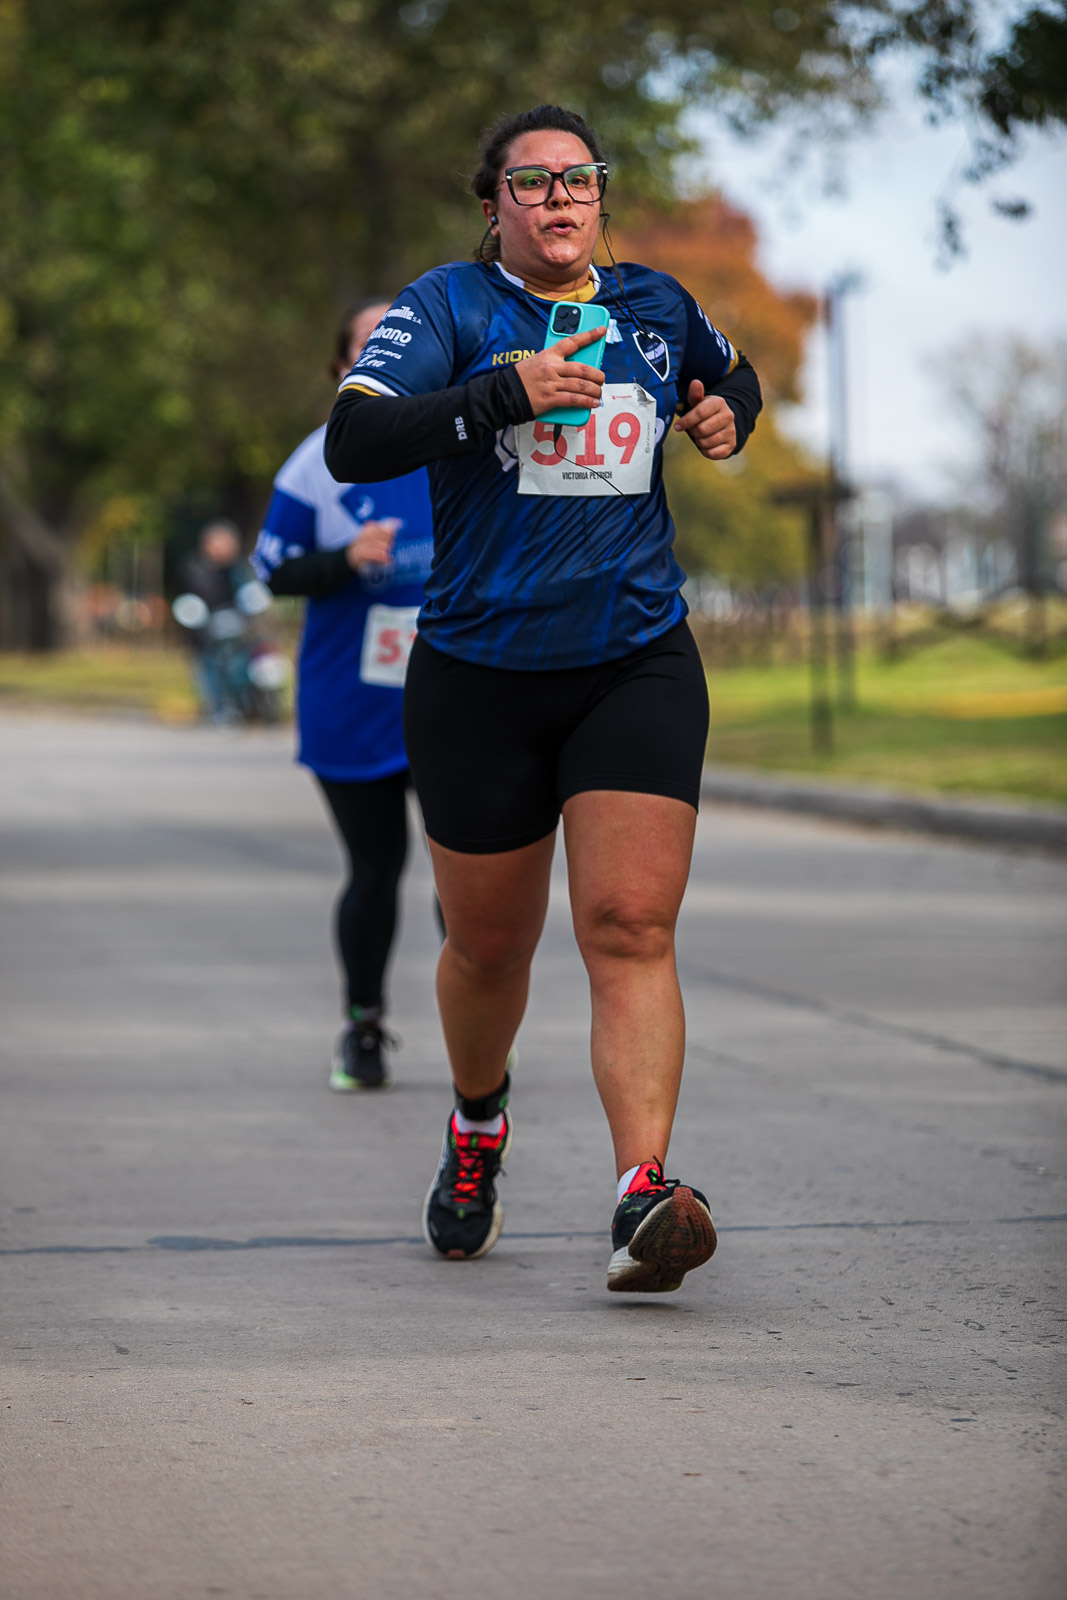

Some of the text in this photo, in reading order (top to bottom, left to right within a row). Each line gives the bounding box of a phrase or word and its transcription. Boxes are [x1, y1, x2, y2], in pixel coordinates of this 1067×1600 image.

[454, 416, 468, 441] DRB
[530, 412, 641, 466] 519
[562, 471, 613, 480] VICTORIA PETRICH
[377, 629, 418, 664] 5
